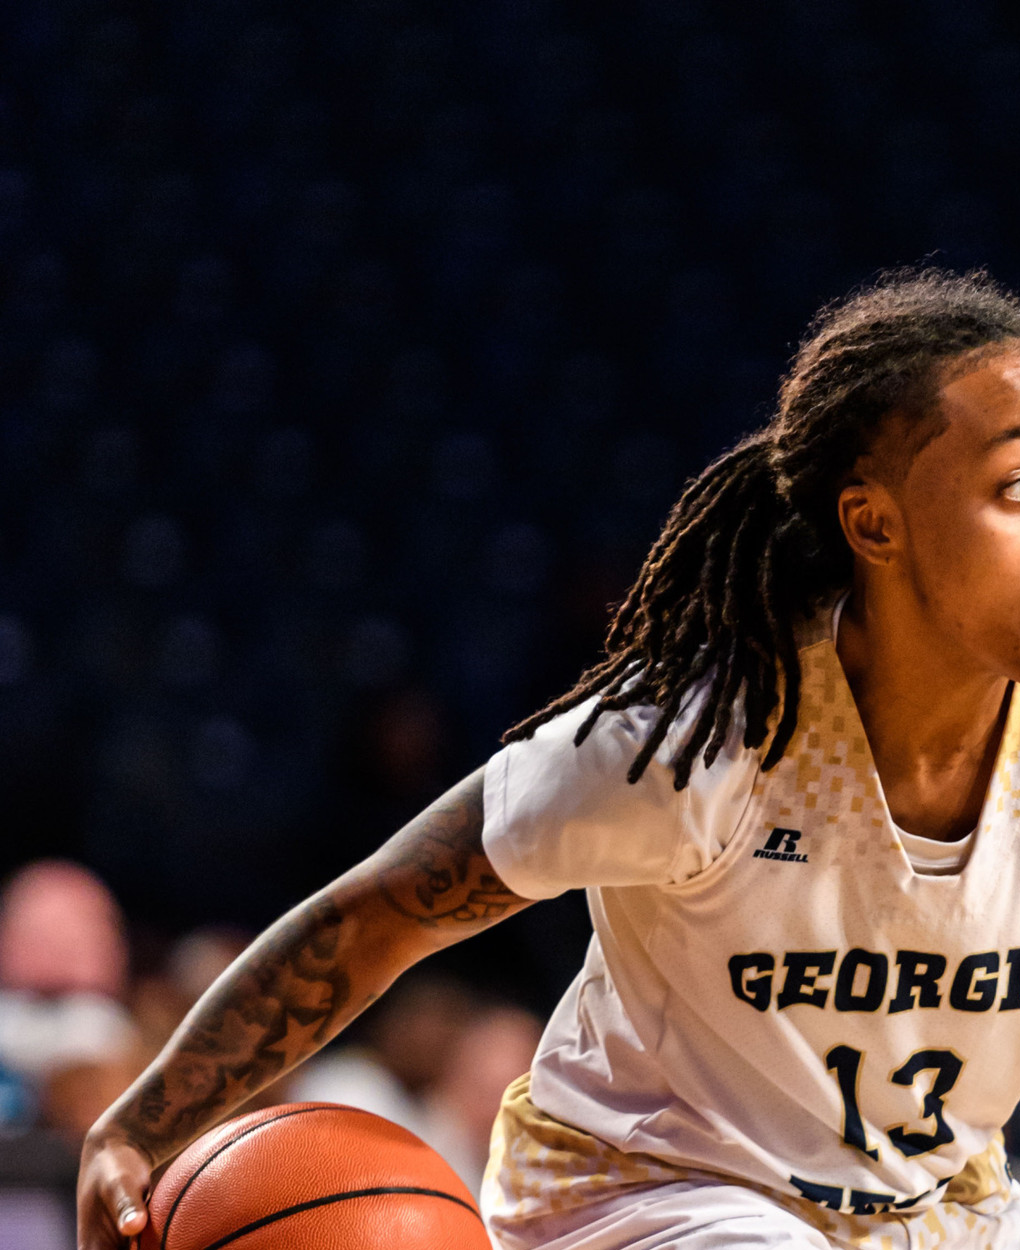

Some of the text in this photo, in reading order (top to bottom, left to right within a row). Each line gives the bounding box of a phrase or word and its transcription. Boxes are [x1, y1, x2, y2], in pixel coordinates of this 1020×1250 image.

[763, 827, 802, 853] R
[753, 849, 809, 863] RUSSELL
[823, 1043, 968, 1163] 13
